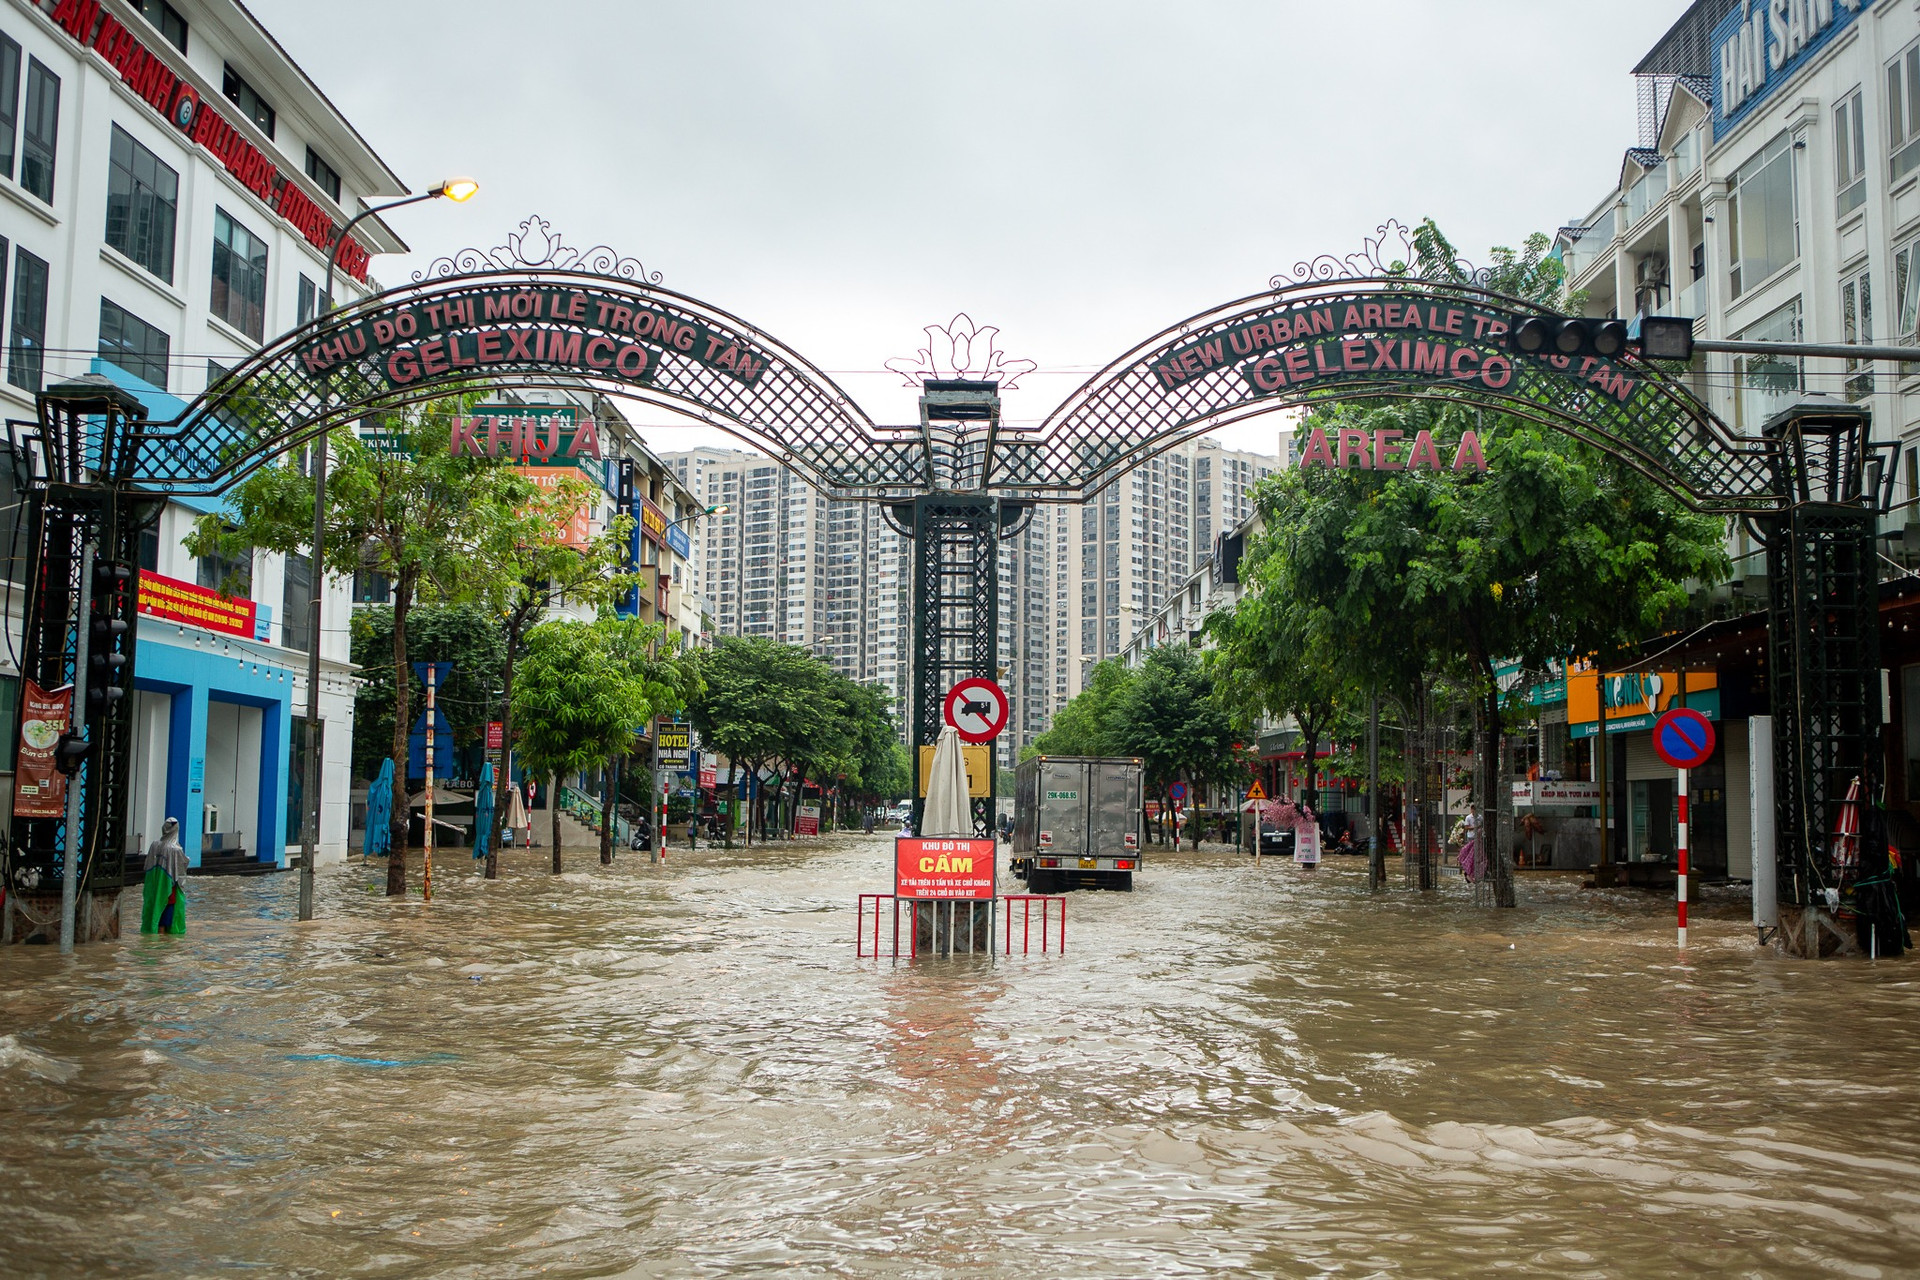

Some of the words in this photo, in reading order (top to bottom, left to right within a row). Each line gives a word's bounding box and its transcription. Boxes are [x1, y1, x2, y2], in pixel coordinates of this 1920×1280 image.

[51, 0, 101, 45] AN
[95, 12, 176, 117] KHANH
[194, 102, 277, 201] BILLIARDS
[277, 180, 333, 252] FITNESS
[335, 233, 370, 285] YOGA
[301, 328, 367, 375] KHU
[373, 308, 417, 346] ĐÔ
[423, 297, 476, 327] THỊ
[483, 289, 543, 320] MỚI
[550, 291, 588, 323] LÊ
[596, 300, 697, 352] TRỌNG
[1157, 337, 1225, 388] NEW
[1228, 308, 1334, 355] URBAN
[1342, 302, 1423, 330] AREA
[1428, 306, 1466, 335] LE
[1471, 314, 1571, 369] TRG
[1578, 355, 1635, 402] TAN
[387, 329, 648, 384] GELEXIMCO
[1252, 338, 1512, 392] GELEXIMCO
[451, 417, 559, 458] KHU
[567, 417, 602, 461] A
[1299, 427, 1443, 471] AREA
[1451, 430, 1488, 472] A
[45, 719, 66, 731] 35K
[659, 735, 689, 746] HOTEL
[658, 748, 672, 758] NHÀ
[1541, 790, 1555, 798] SHOP
[1556, 790, 1568, 798] HOA
[919, 852, 973, 873] CẤM
[922, 842, 940, 851] KHU
[942, 840, 954, 851] ĐÔ
[956, 842, 970, 853] THỊ
